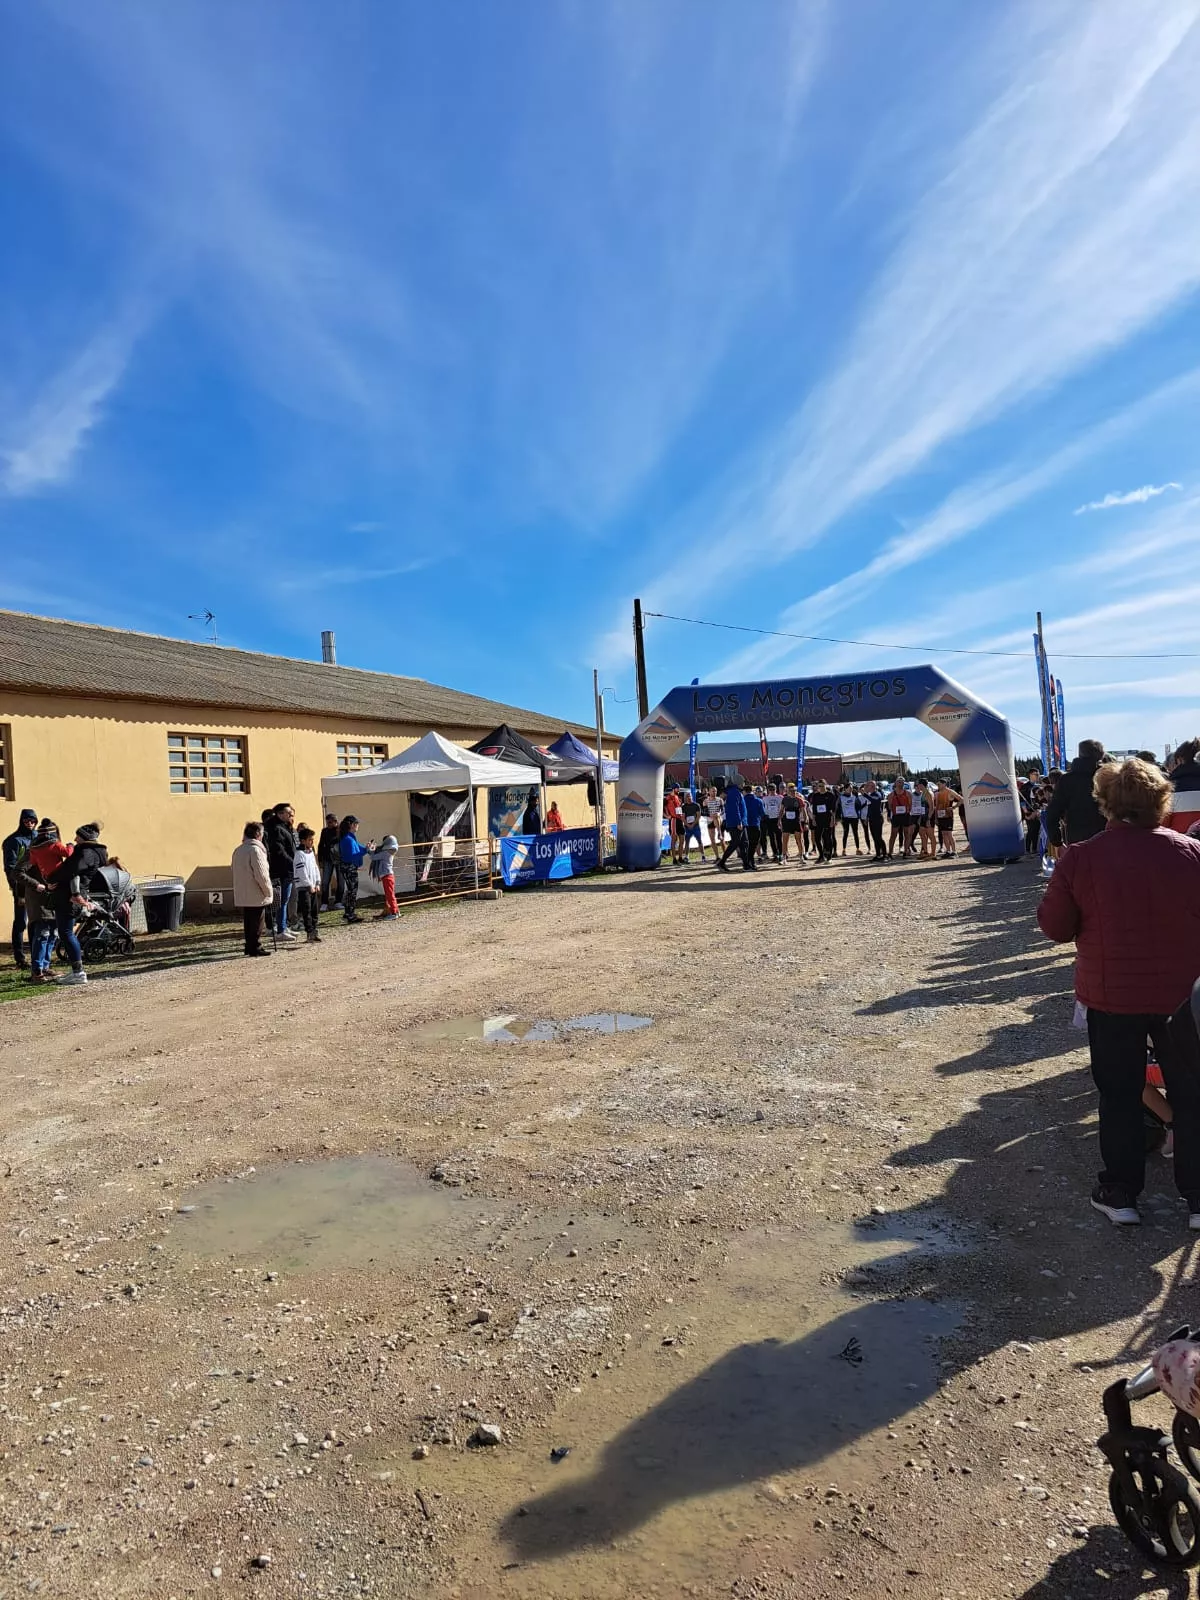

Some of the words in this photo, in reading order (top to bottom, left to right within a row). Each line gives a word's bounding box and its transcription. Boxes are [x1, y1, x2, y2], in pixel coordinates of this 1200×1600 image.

[693, 691, 740, 713] Los
[751, 677, 906, 709] Monegros
[694, 711, 757, 726] CONSEJO
[761, 705, 838, 722] COMARCAL
[535, 842, 552, 859] Los
[554, 838, 594, 856] Monegros
[212, 892, 220, 904] 2
